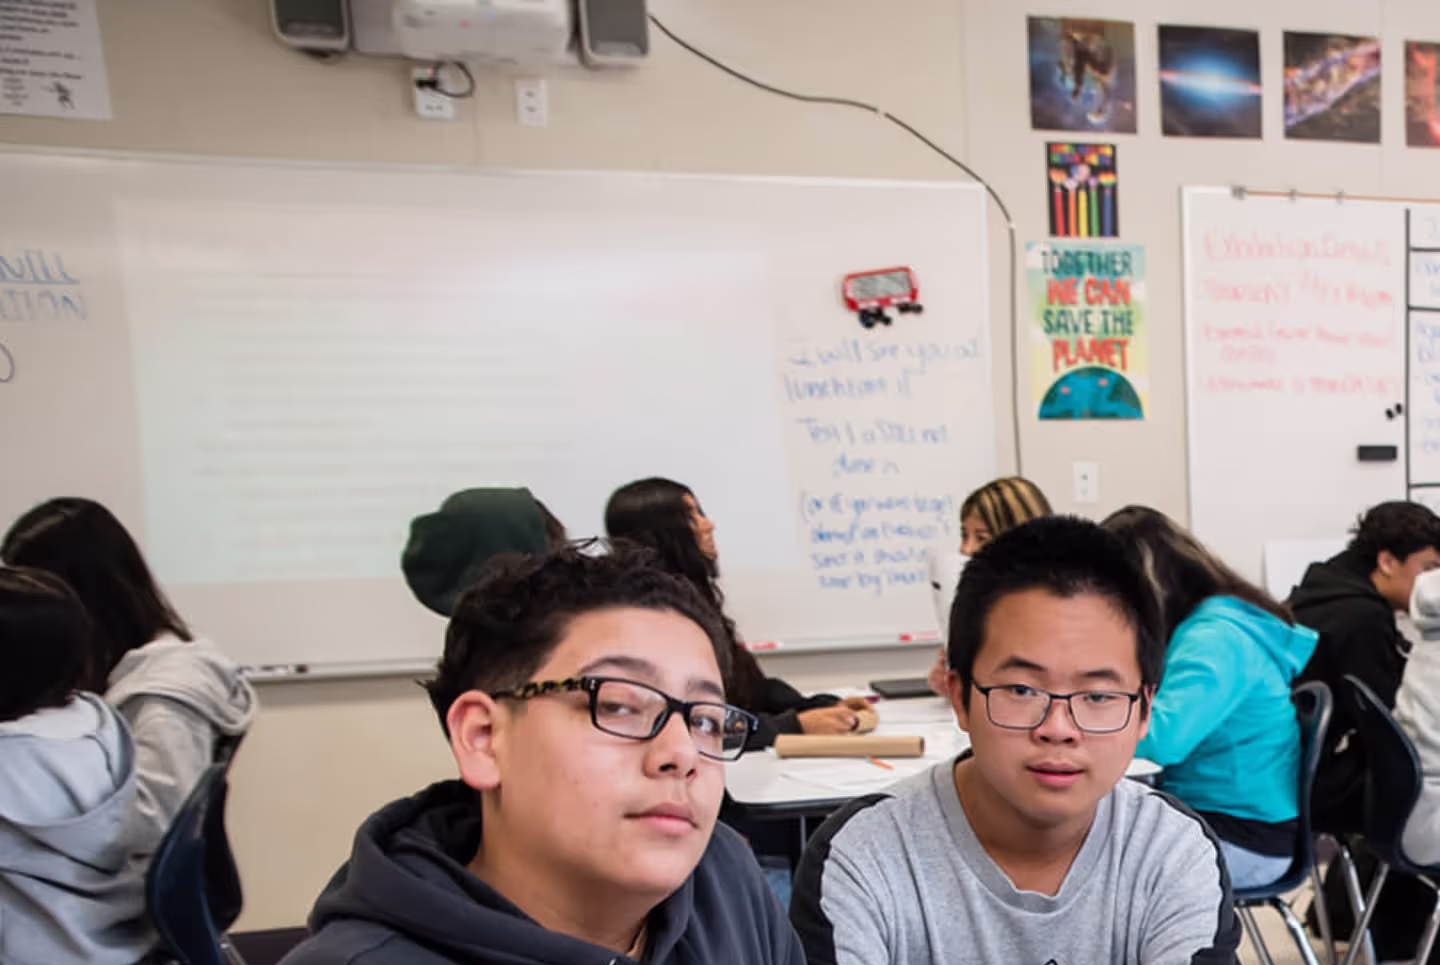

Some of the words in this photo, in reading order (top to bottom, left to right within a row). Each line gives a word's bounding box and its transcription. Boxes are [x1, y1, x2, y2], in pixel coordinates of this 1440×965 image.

[1041, 250, 1133, 275] TOGETHER
[1046, 277, 1079, 305] WE
[1084, 278, 1132, 306] CAN
[1043, 309, 1093, 335] SAVE
[1100, 310, 1133, 336] THE
[1052, 338, 1128, 372] PLANET
